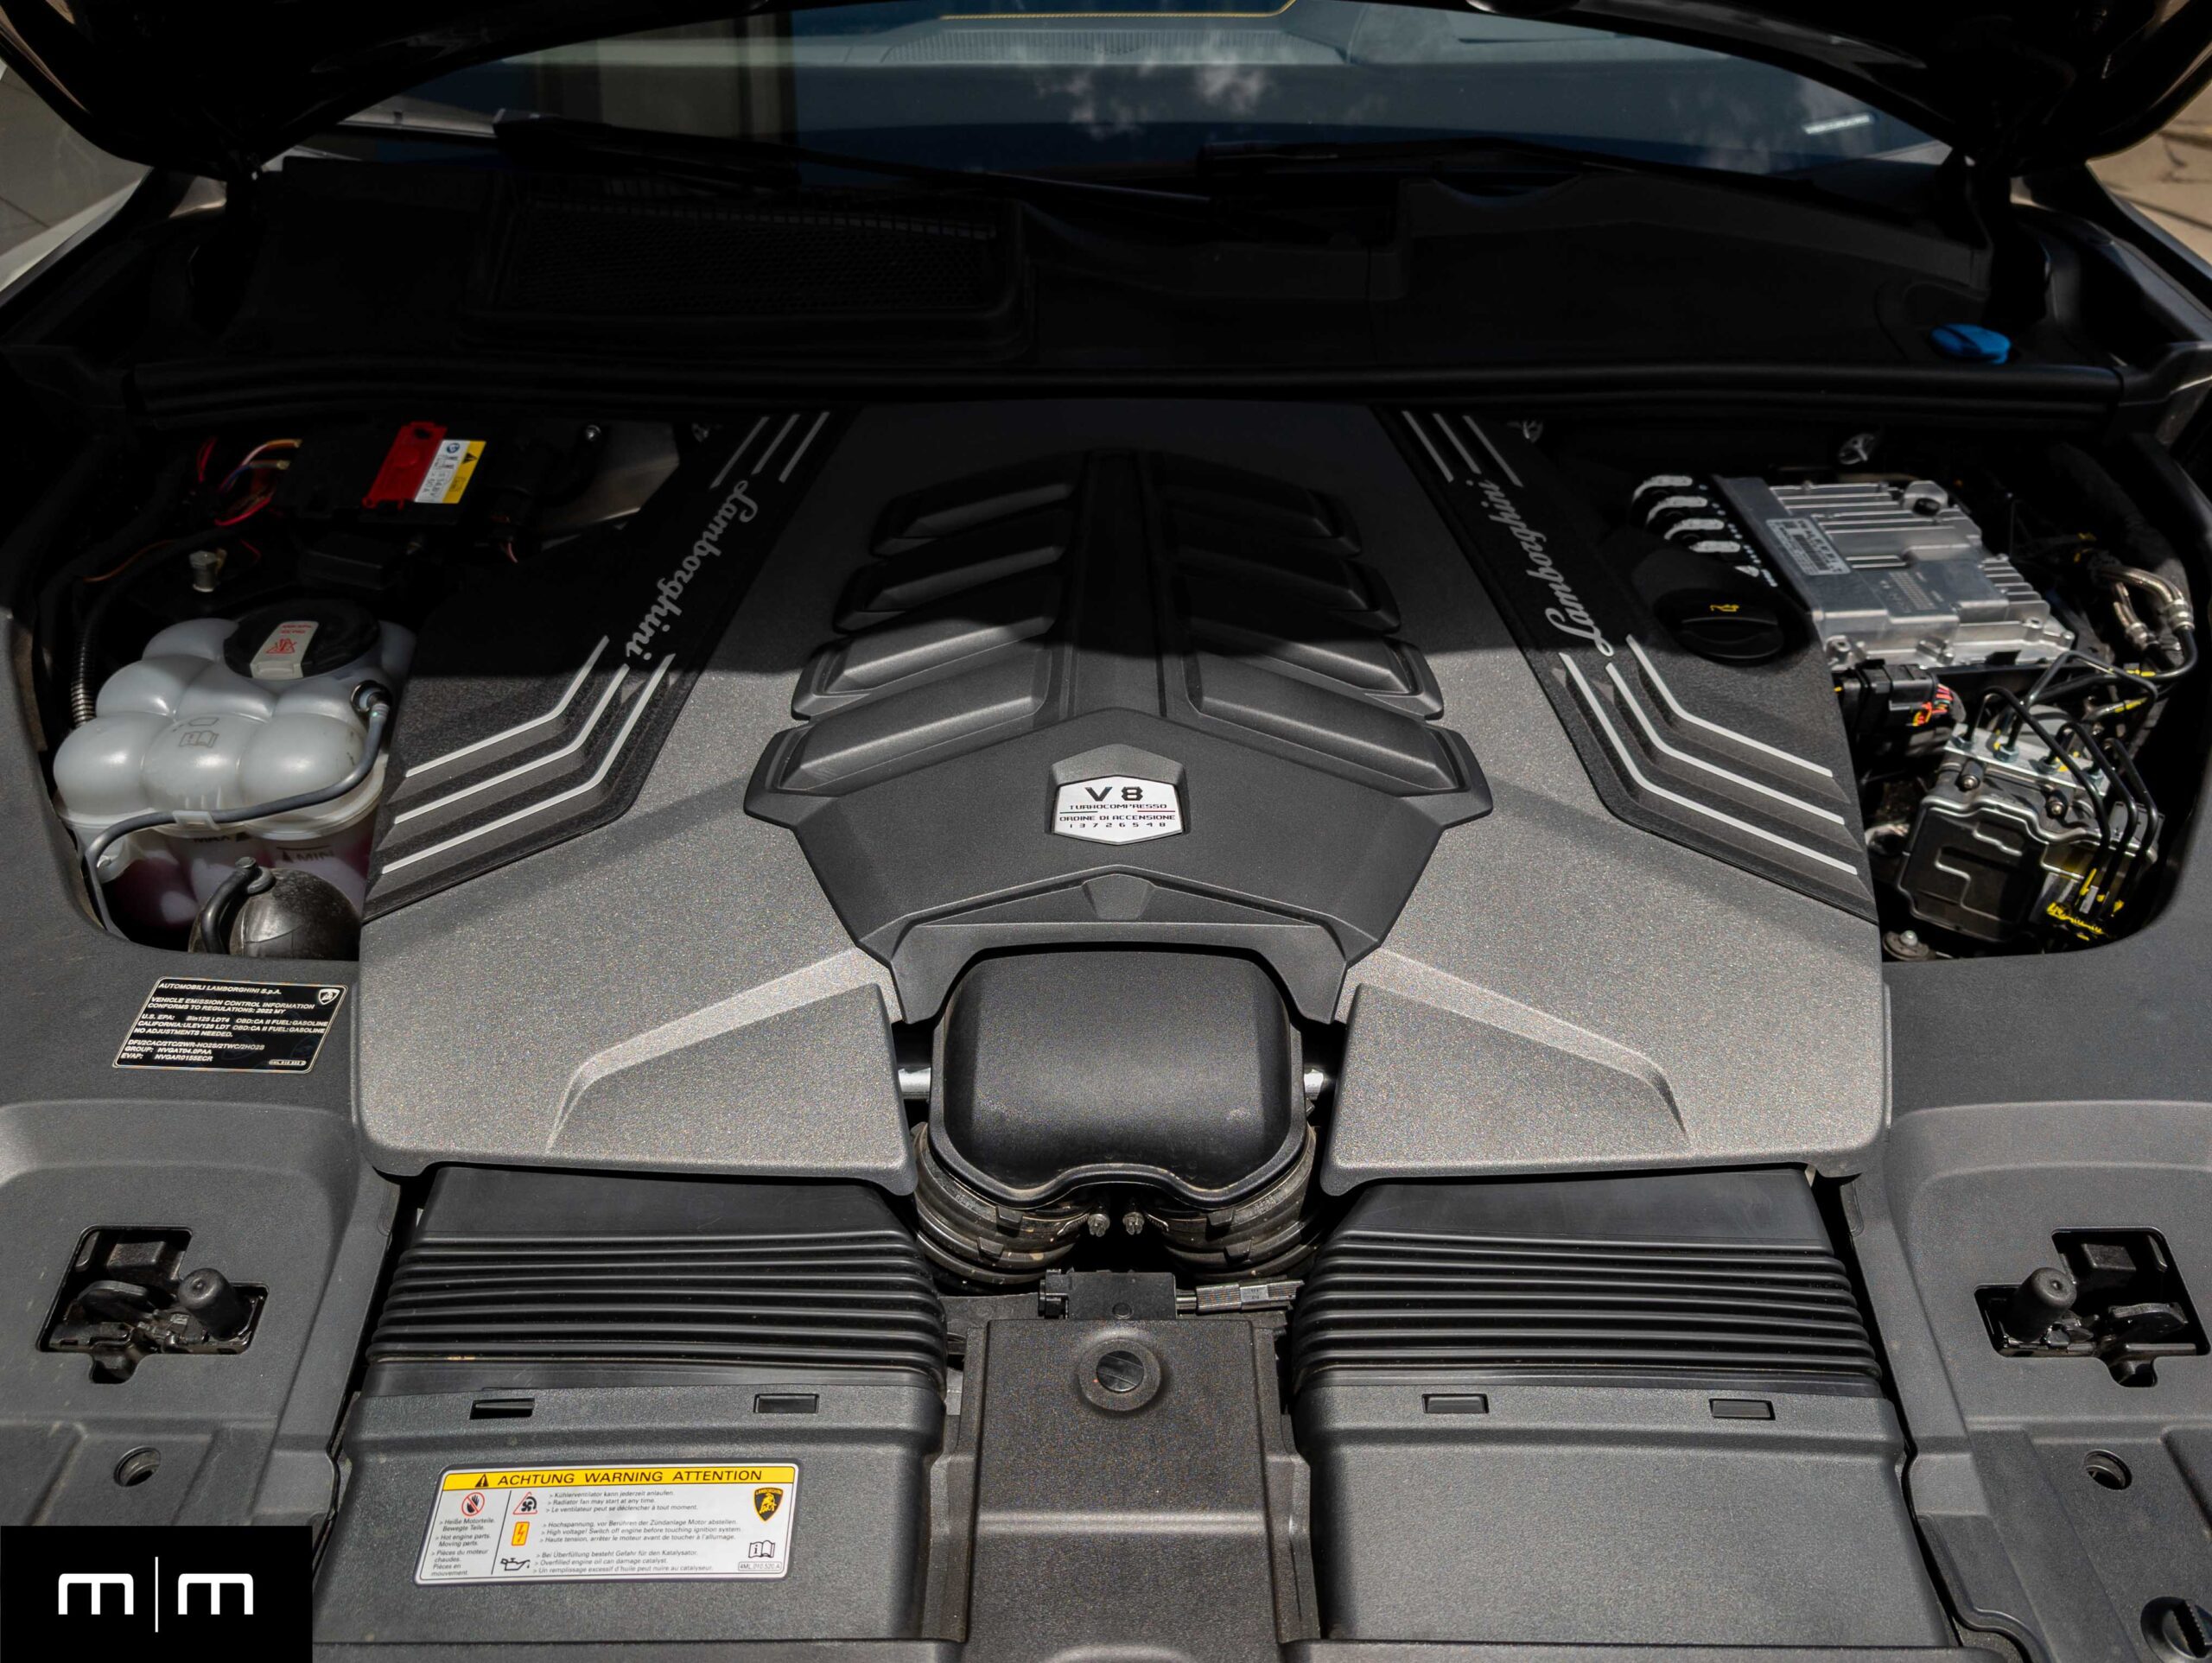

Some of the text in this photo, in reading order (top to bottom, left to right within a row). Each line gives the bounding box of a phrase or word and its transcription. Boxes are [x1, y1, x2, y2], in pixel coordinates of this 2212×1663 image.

[626, 480, 758, 660] Lamborghini
[1465, 479, 1614, 657] Lamborghini
[207, 985, 260, 993] LAMBORGHINI
[497, 1470, 762, 1486] ACHTUNG WARNING ATTENTION
